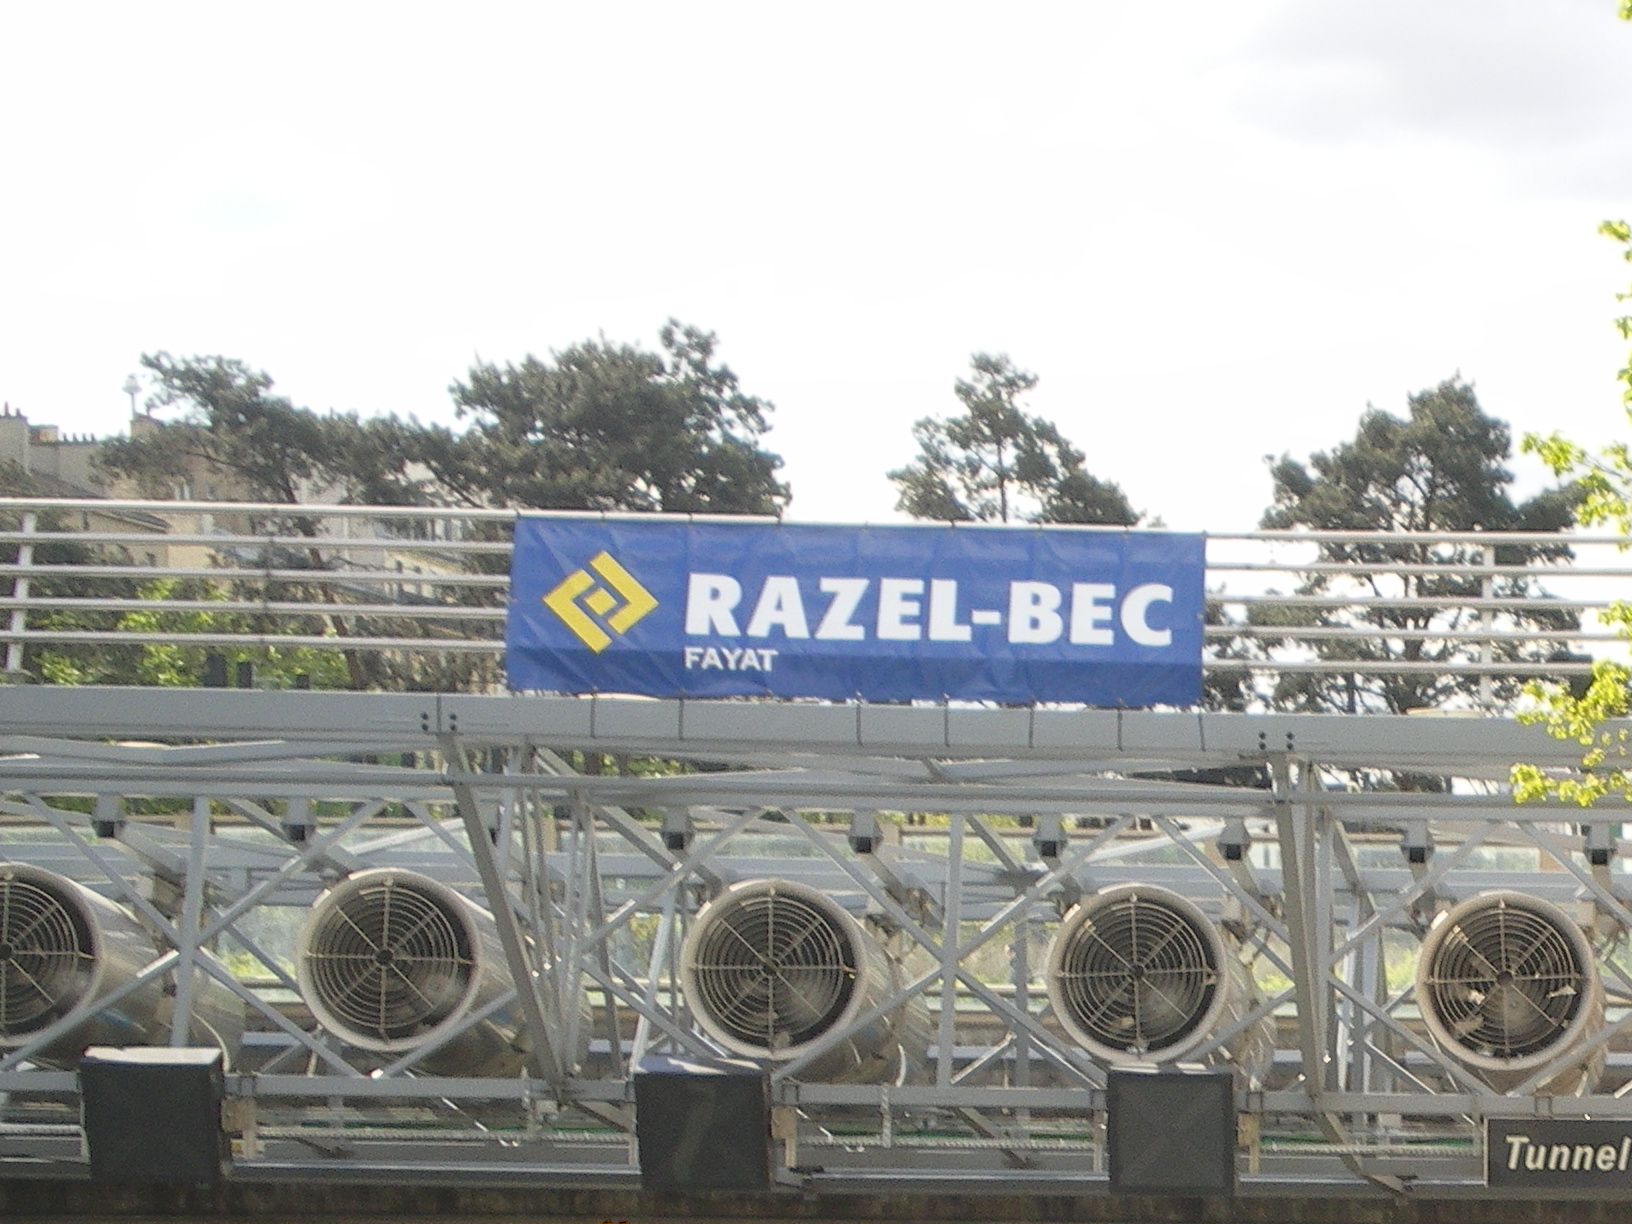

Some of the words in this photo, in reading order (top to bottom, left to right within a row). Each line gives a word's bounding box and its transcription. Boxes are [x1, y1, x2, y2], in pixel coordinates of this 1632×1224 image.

[685, 572, 1174, 647] RAZEL-BEC
[685, 647, 778, 672] FAYAT
[1505, 1134, 1632, 1172] Tunnel
